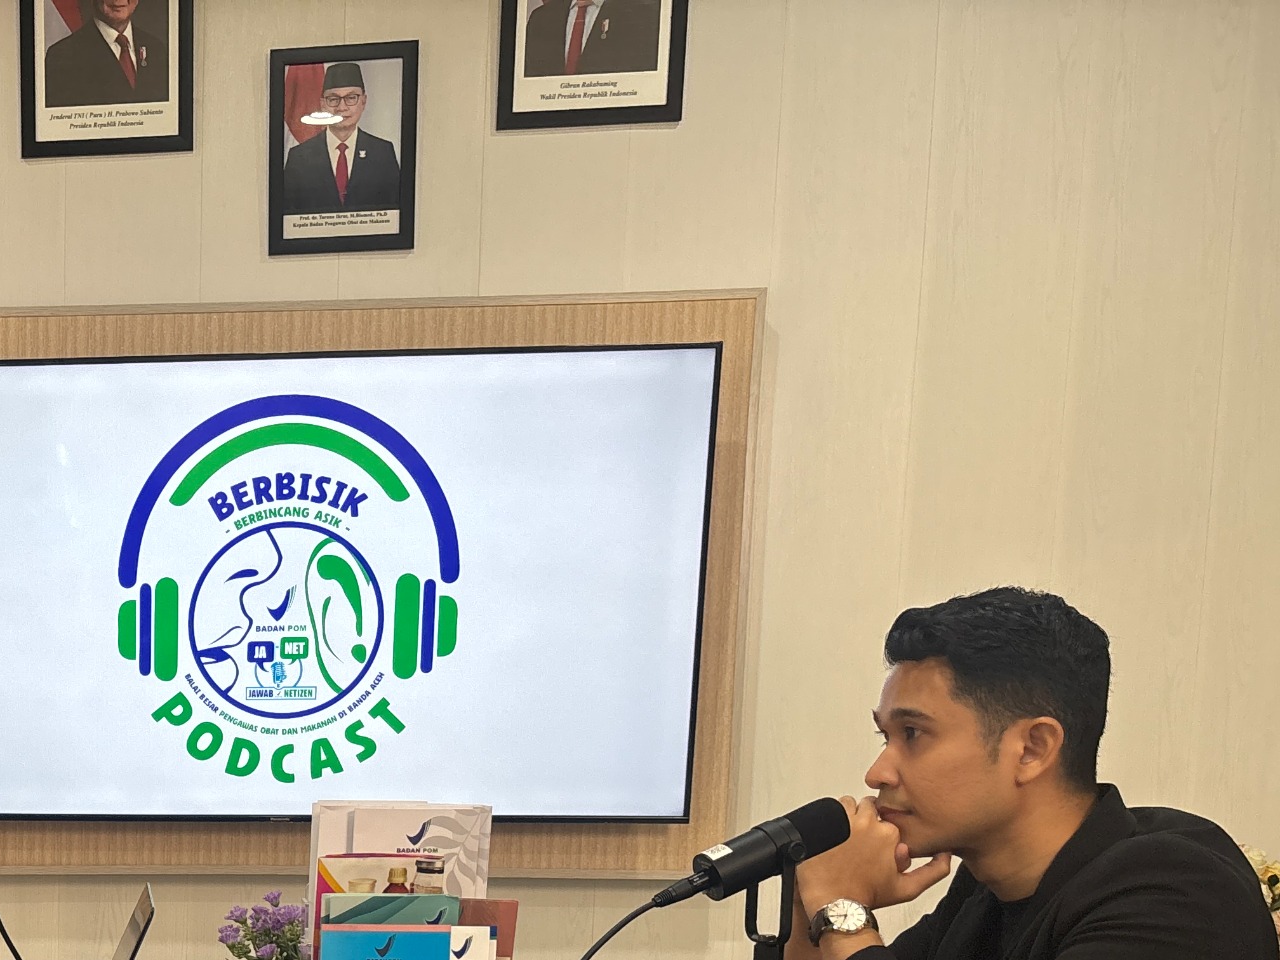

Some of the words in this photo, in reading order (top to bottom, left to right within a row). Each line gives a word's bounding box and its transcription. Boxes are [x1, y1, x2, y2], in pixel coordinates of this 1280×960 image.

[208, 473, 368, 522] BERBISIK
[234, 507, 309, 532] BERBINCANG
[315, 510, 342, 530] ASIK
[254, 646, 266, 658] JA
[285, 642, 305, 654] NET
[184, 673, 201, 694] BALAI
[199, 693, 219, 713] BESAR
[219, 711, 258, 733] PENGAWAS
[260, 727, 279, 735] OBAT
[301, 716, 337, 733] MAKANAN
[338, 711, 347, 719] DI
[348, 690, 372, 712] BANDA
[370, 671, 385, 691] ACEH
[151, 691, 406, 783] PODCAST
